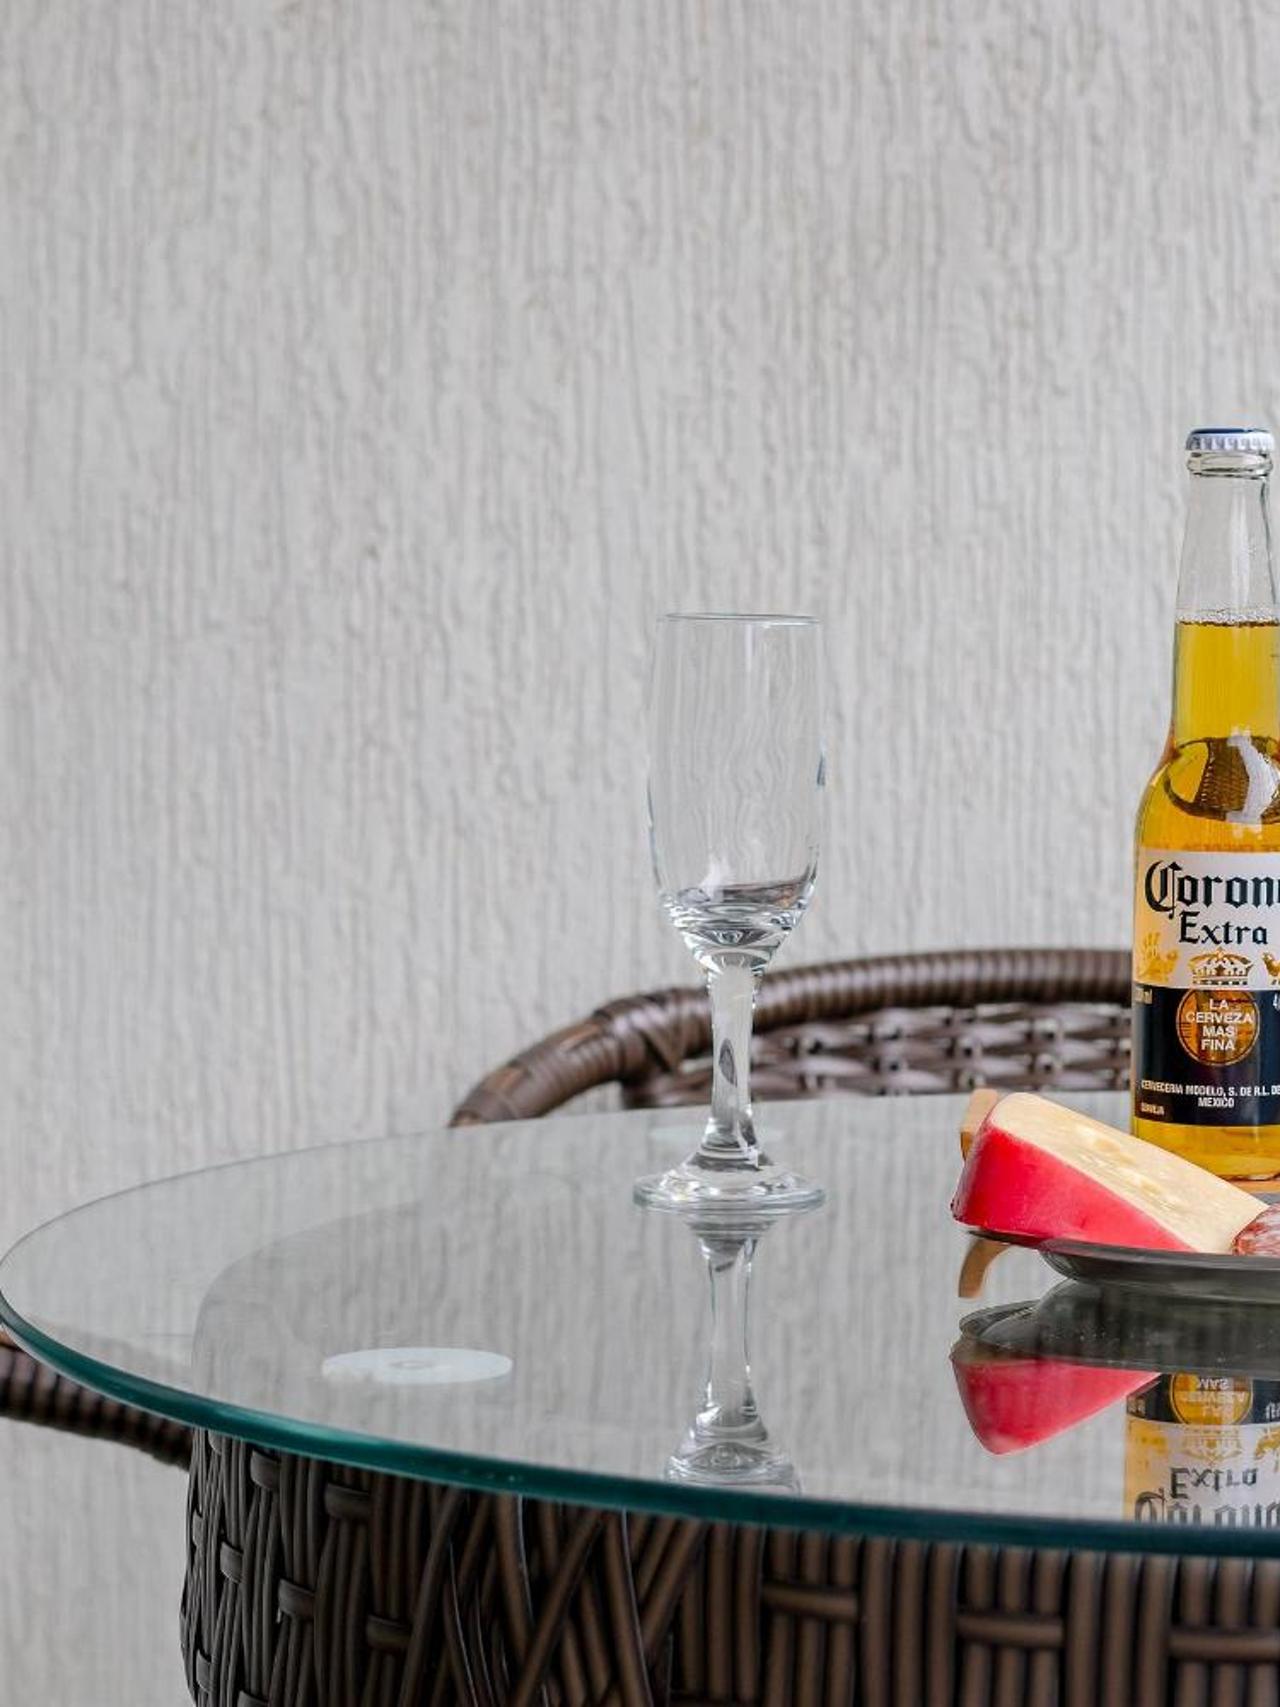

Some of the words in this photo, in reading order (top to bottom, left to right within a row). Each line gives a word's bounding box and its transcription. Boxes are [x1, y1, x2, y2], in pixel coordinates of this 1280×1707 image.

[1179, 911, 1268, 945] Extra
[1209, 998, 1229, 1011] LA
[1185, 1010, 1255, 1024] CERVEZA
[1202, 1025, 1235, 1037] MAS
[1201, 1039, 1236, 1051] FINA
[1240, 1086, 1252, 1097] DE
[1198, 1097, 1235, 1108] MEXICO
